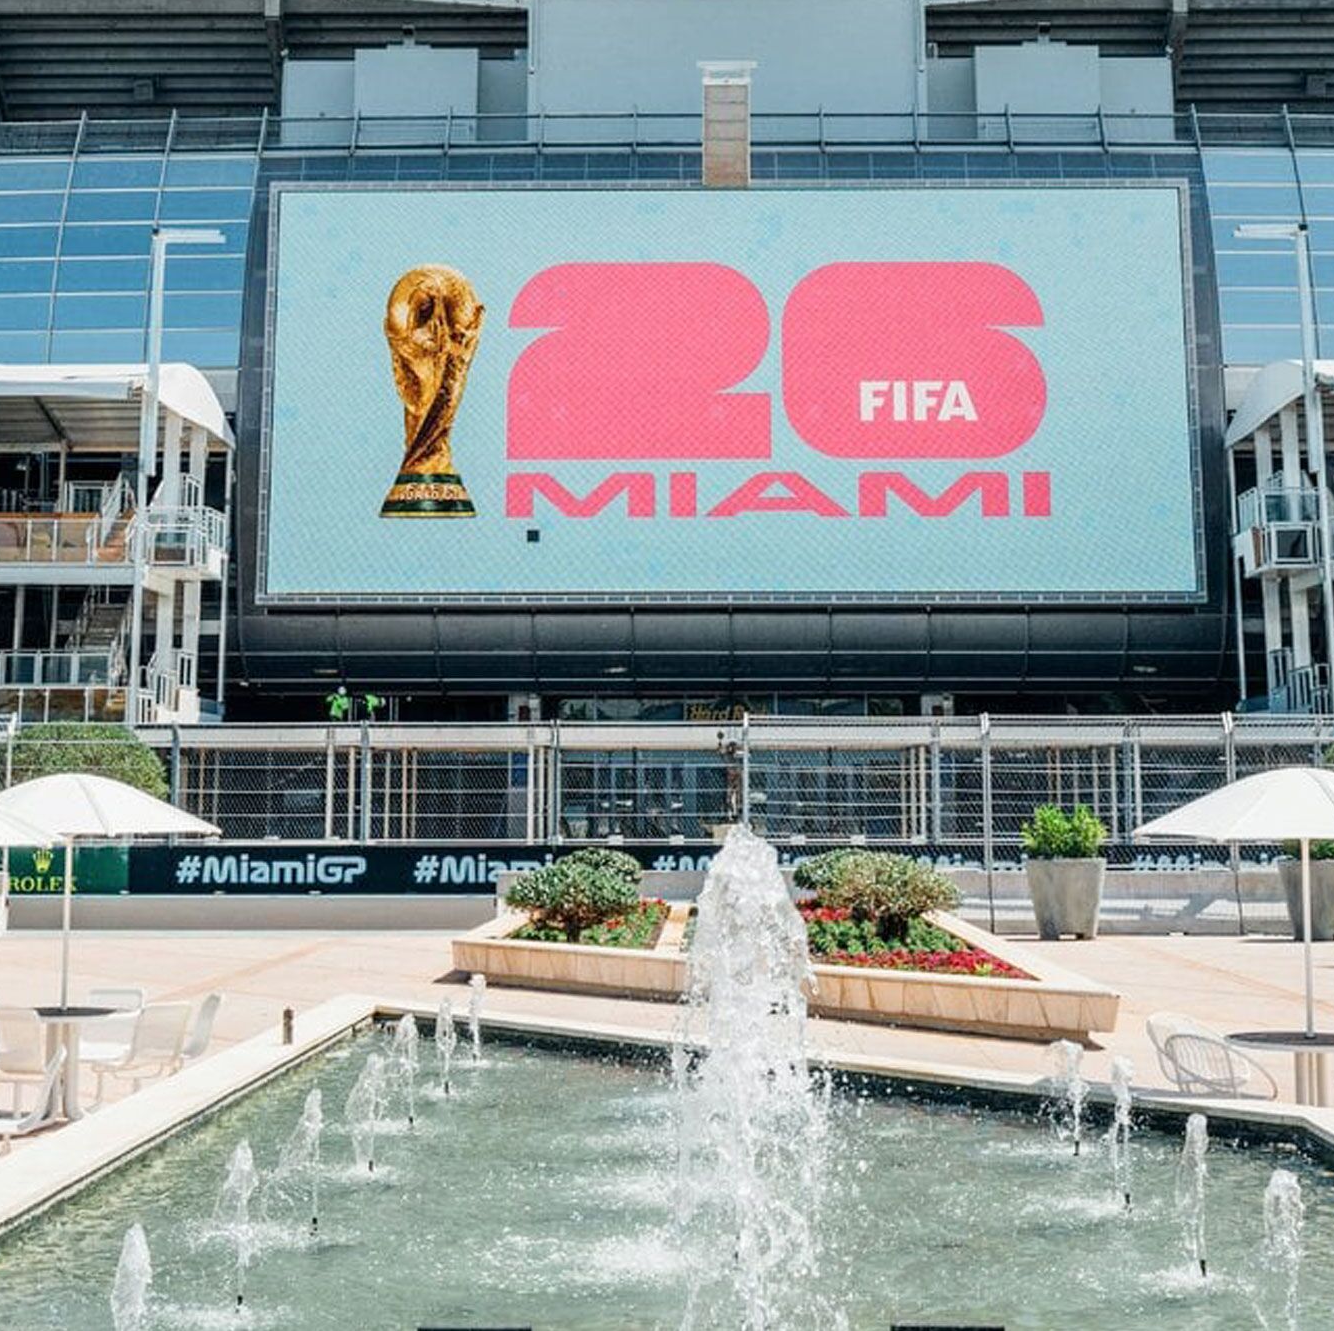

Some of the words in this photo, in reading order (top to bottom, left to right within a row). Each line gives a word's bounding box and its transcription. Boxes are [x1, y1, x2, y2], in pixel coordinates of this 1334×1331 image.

[506, 261, 1047, 459] 26
[858, 380, 978, 421] FIFA
[505, 471, 1051, 518] MIAMI
[175, 853, 367, 884] #MiamiGP
